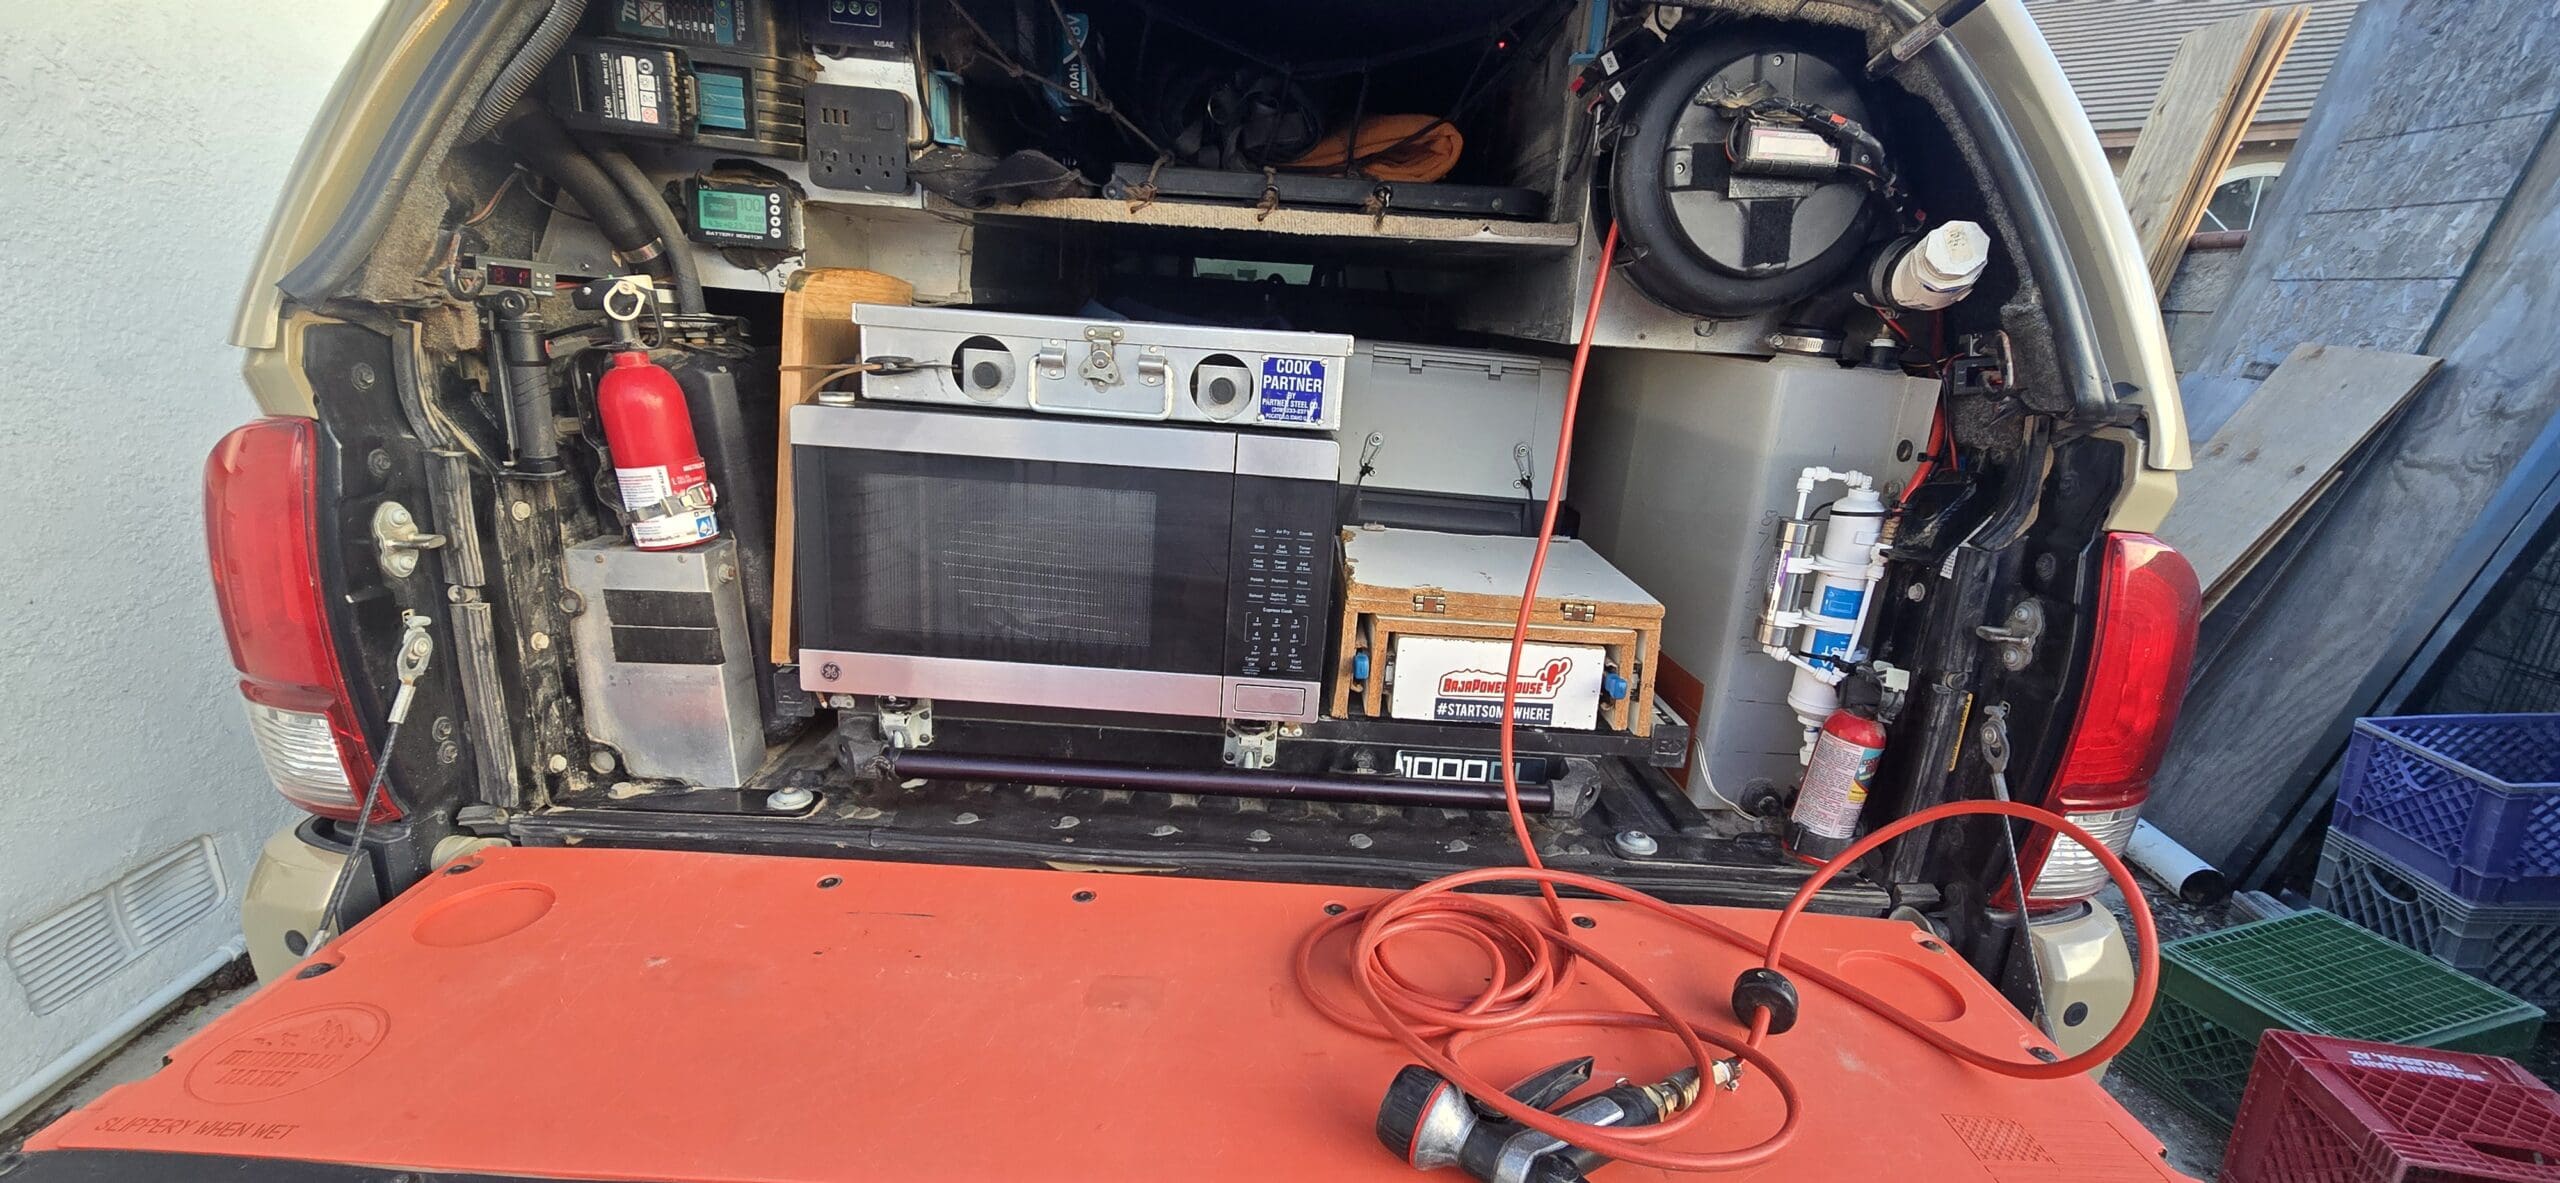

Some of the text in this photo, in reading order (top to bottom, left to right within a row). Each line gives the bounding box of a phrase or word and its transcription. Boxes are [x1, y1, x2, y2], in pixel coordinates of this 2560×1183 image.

[873, 40, 895, 48] KISAE
[705, 230, 764, 240] BATTERY MONITOR
[1276, 359, 1312, 376] COOK
[1263, 375, 1322, 393] PARTNER
[1262, 398, 1289, 407] PARTNER
[1290, 400, 1308, 409] STEEL
[1443, 678, 1543, 694] BAJAPOWEROUSE
[1436, 702, 1551, 721] #STARTSOMWHERE
[95, 1116, 300, 1141] SLIPPERY WHEN WET
